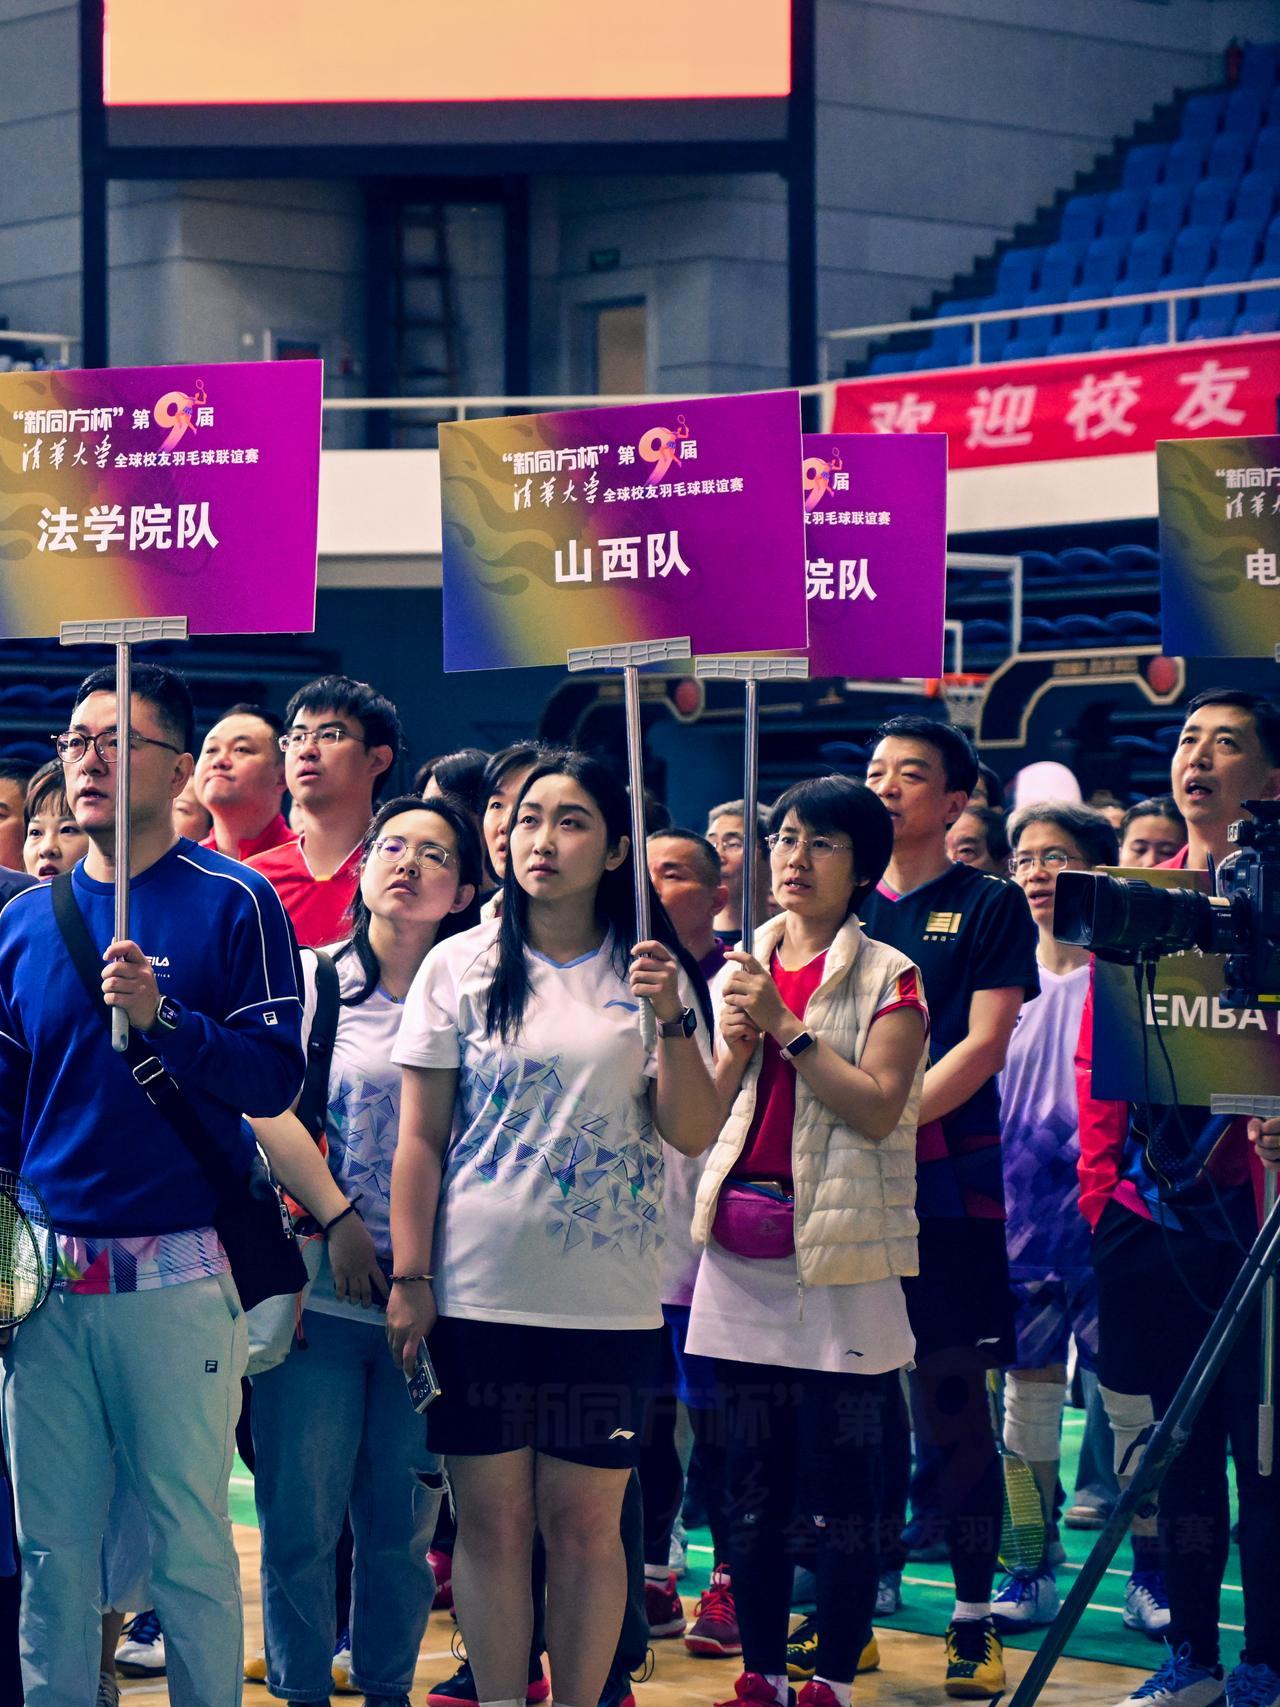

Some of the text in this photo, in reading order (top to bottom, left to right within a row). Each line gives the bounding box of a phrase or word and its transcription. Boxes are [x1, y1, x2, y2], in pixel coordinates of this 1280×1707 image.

[114, 448, 259, 469] 全球校友羽毛球联谊赛
[603, 477, 744, 503] 全球校友羽毛球联谊赛
[36, 501, 219, 553] 法学院队
[554, 530, 691, 583] 山西队
[1145, 993, 1268, 1031] EMBA
